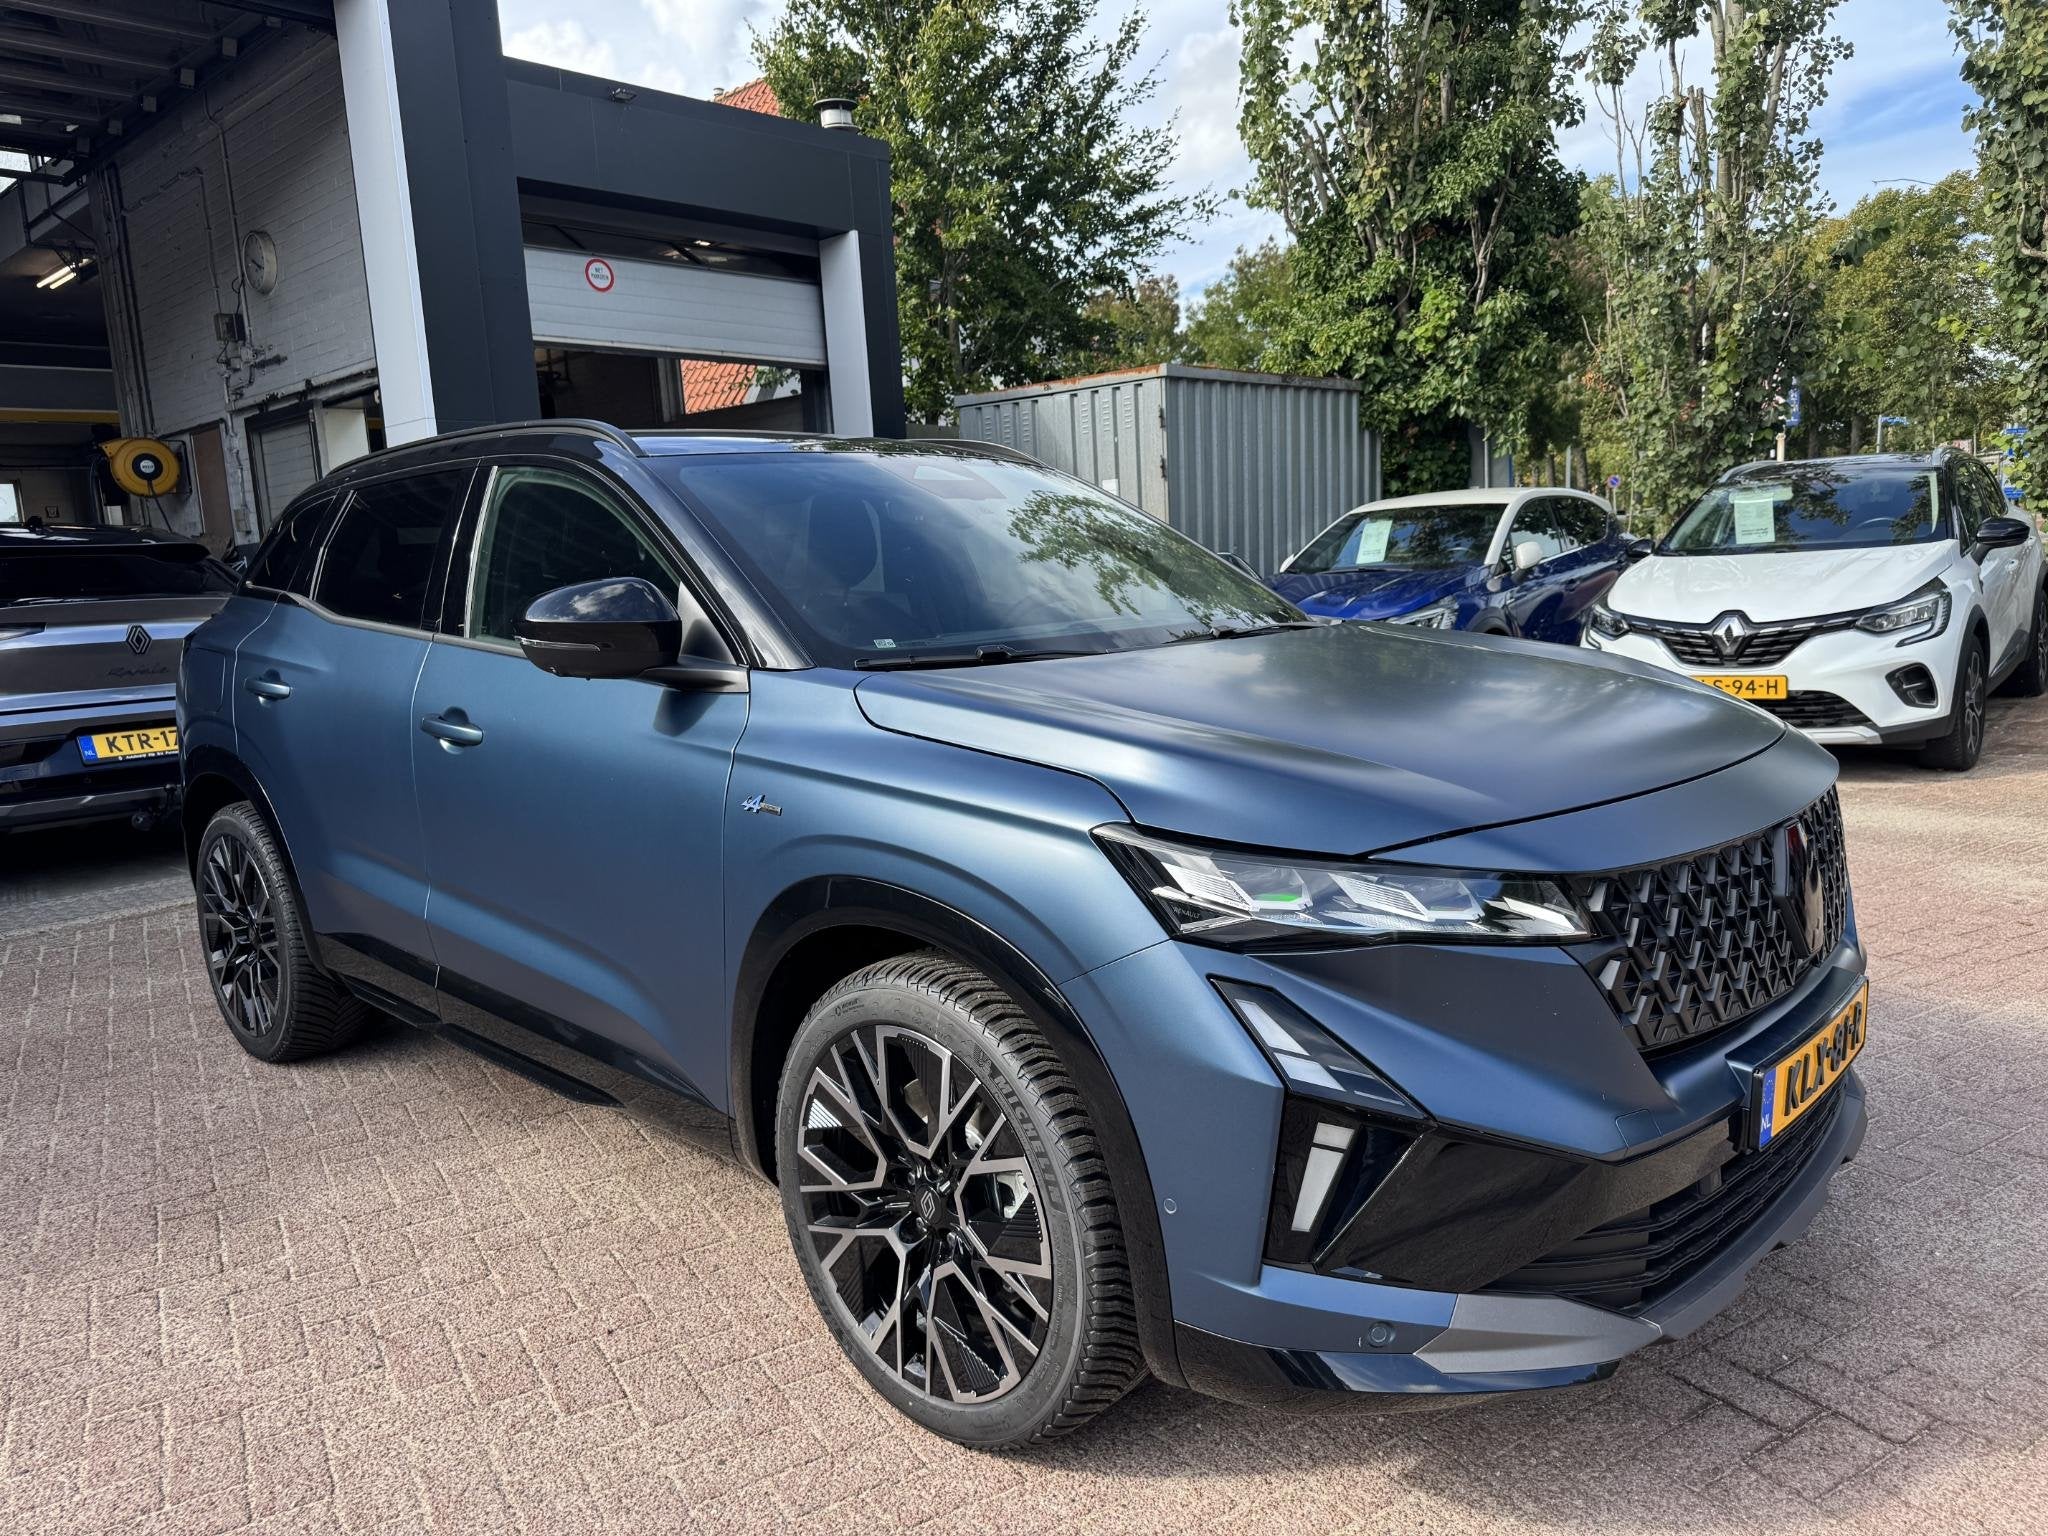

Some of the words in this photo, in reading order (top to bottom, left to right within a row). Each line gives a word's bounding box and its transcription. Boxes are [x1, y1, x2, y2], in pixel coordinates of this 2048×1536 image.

[1701, 679, 1779, 695] S-94-H
[1761, 1113, 1772, 1133] NL
[993, 1074, 1062, 1201] MICHELIN
